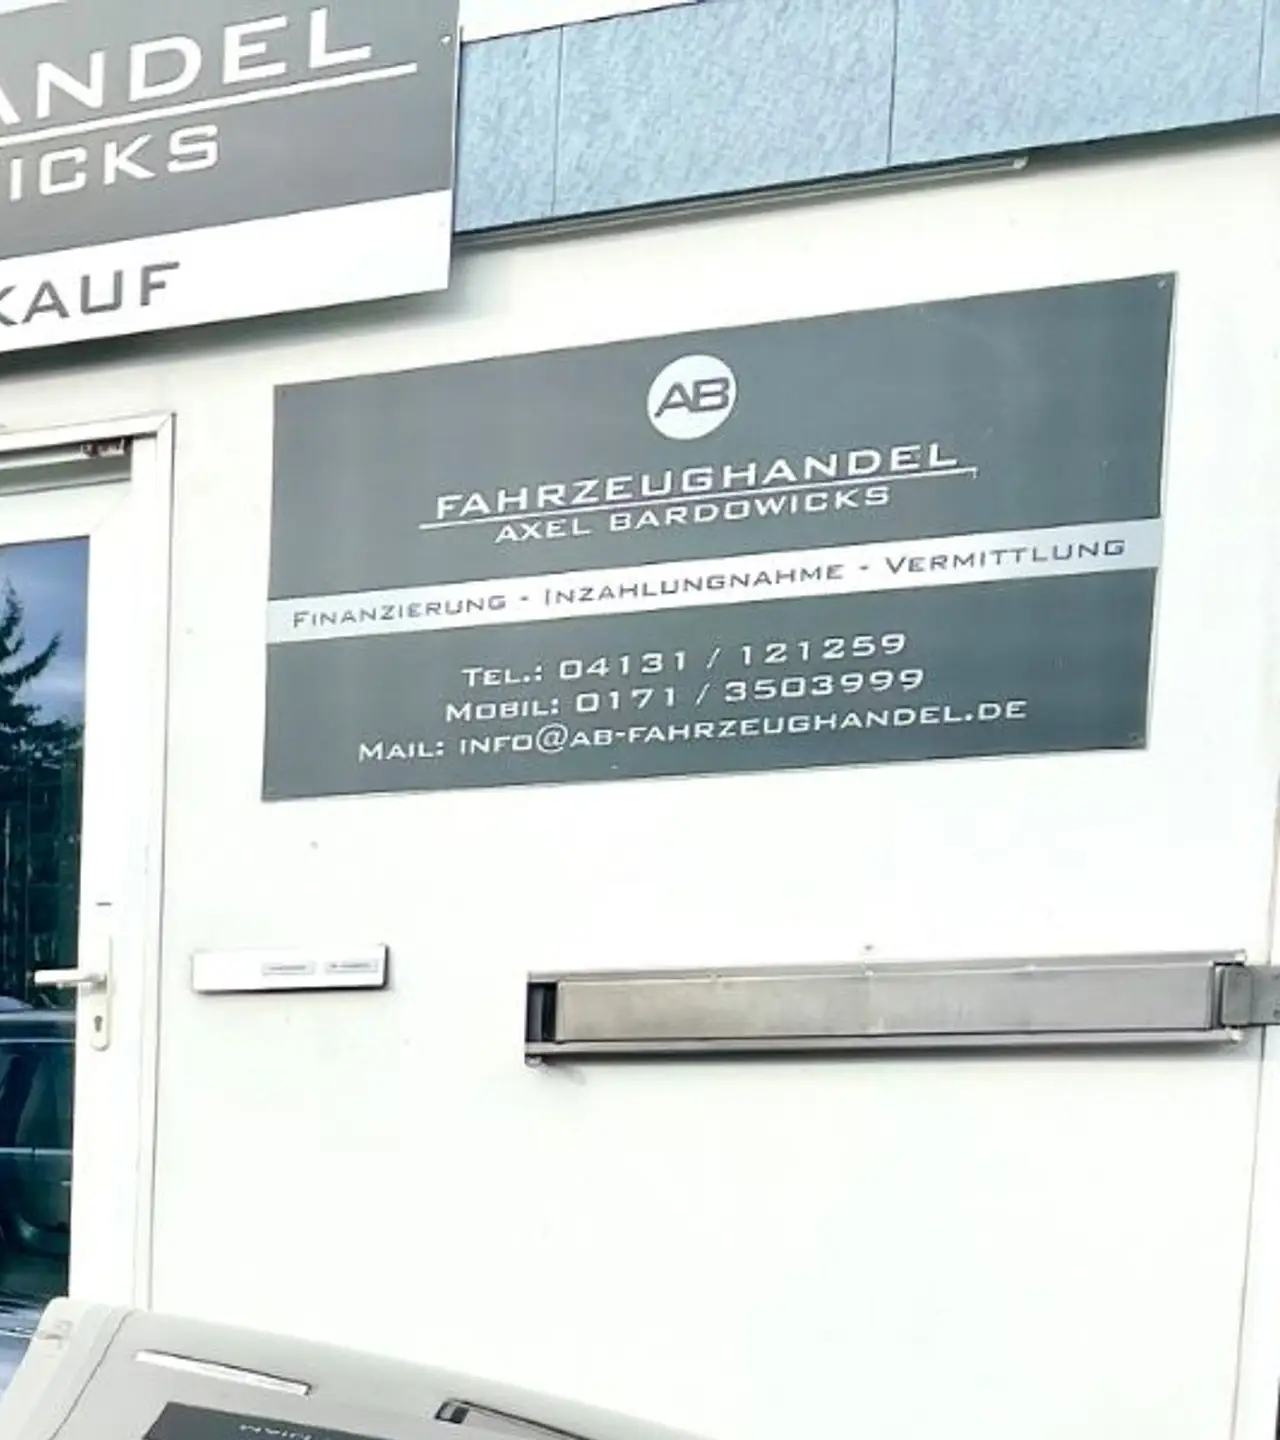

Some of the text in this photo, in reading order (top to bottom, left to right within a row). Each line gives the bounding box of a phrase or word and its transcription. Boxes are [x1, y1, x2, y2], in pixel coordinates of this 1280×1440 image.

[653, 376, 731, 418] AB
[435, 441, 960, 520] FAHRZEUGHANDEL
[494, 485, 891, 544] AXEL BARDOWICKS
[292, 594, 507, 629] FINANZIERUNG
[543, 563, 845, 606] INZAHLUNGNAHME
[884, 538, 1127, 575] VERMITTLUNG
[460, 632, 907, 688] TEL.: 04131 / 121259
[445, 668, 925, 724] MOBIL: 0171 / 3503999
[358, 700, 1028, 762] MAIL: INFO@AB-FAHRZEUGHANDEL.DE
